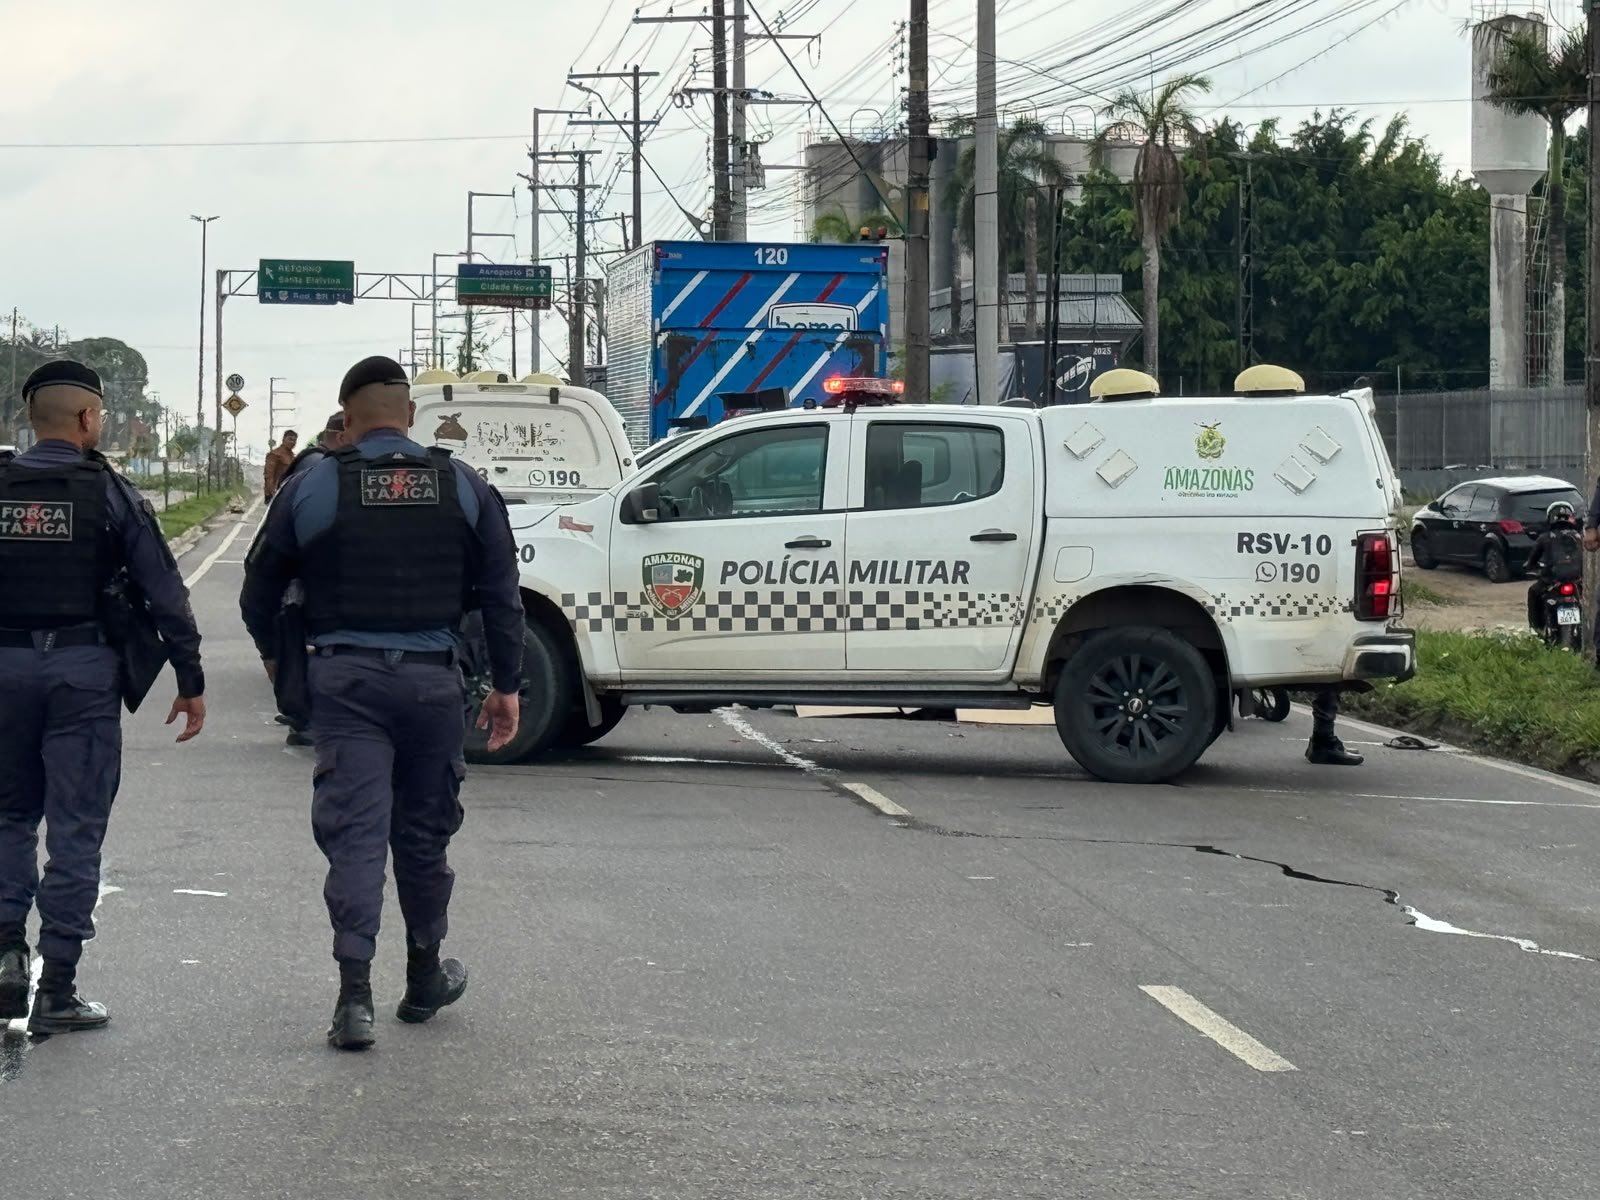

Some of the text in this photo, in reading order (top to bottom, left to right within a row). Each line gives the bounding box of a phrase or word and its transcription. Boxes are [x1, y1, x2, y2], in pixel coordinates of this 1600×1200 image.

[754, 248, 788, 265] 120
[367, 474, 432, 486] FORÇA
[548, 470, 581, 486] 190
[1163, 468, 1254, 491] AMAZONAS
[1, 506, 66, 521] FORÇA
[1237, 532, 1332, 555] RSV-10
[644, 554, 702, 569] AMAZONAS
[720, 555, 970, 585] POLÍCIA MILITAR
[1281, 563, 1320, 583] 190
